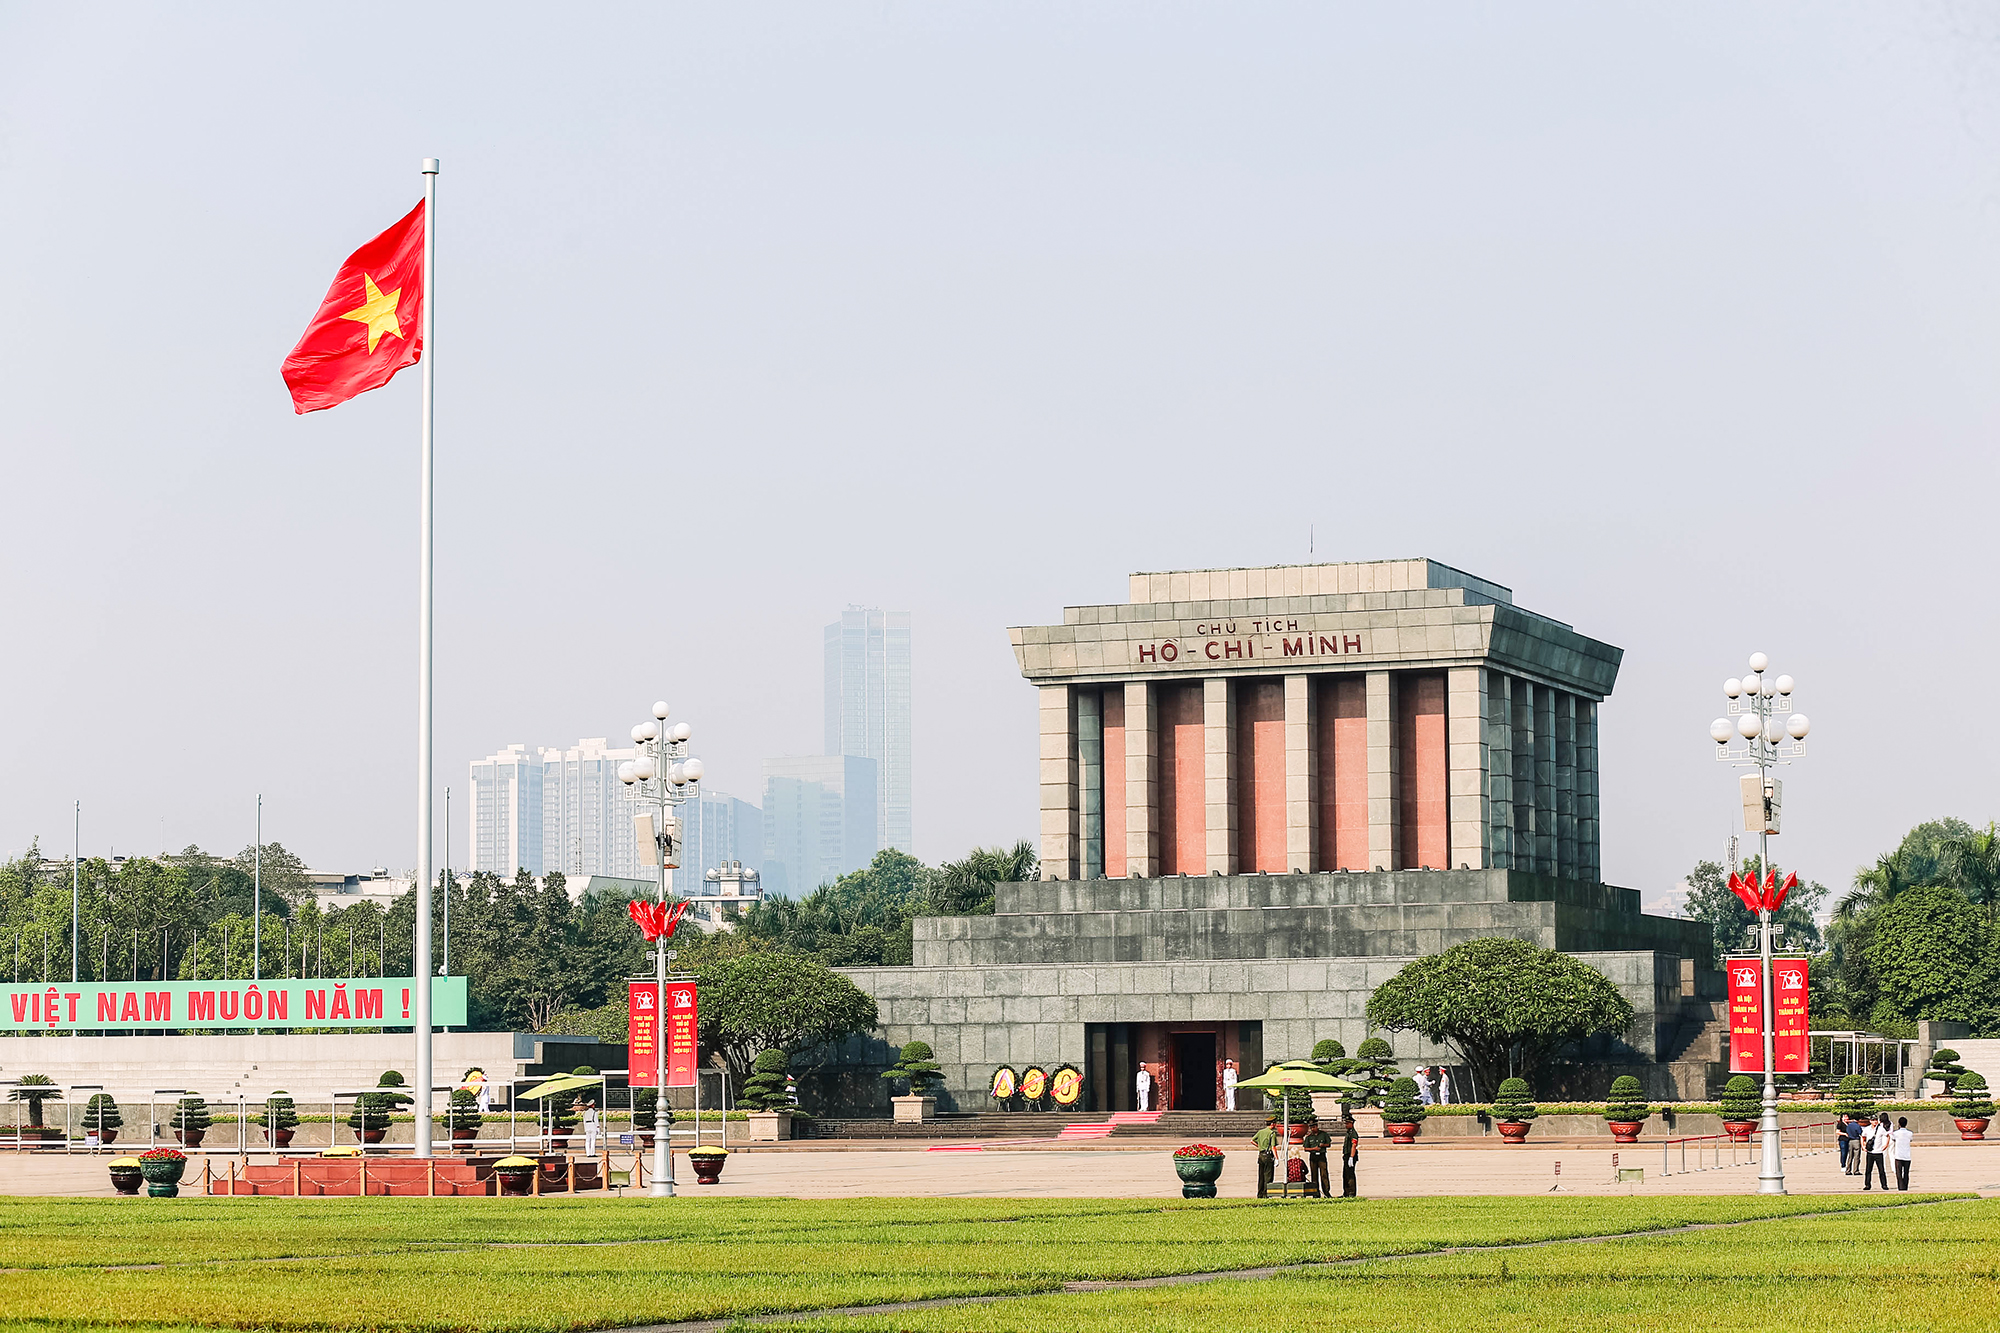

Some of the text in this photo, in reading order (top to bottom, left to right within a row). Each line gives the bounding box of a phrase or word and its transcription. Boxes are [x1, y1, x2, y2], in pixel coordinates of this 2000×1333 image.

[1138, 638, 1179, 663] HỒ
[1205, 633, 1255, 660] CHÍ
[10, 982, 410, 1028] VIỆT NAM MUÔN NĂM !
